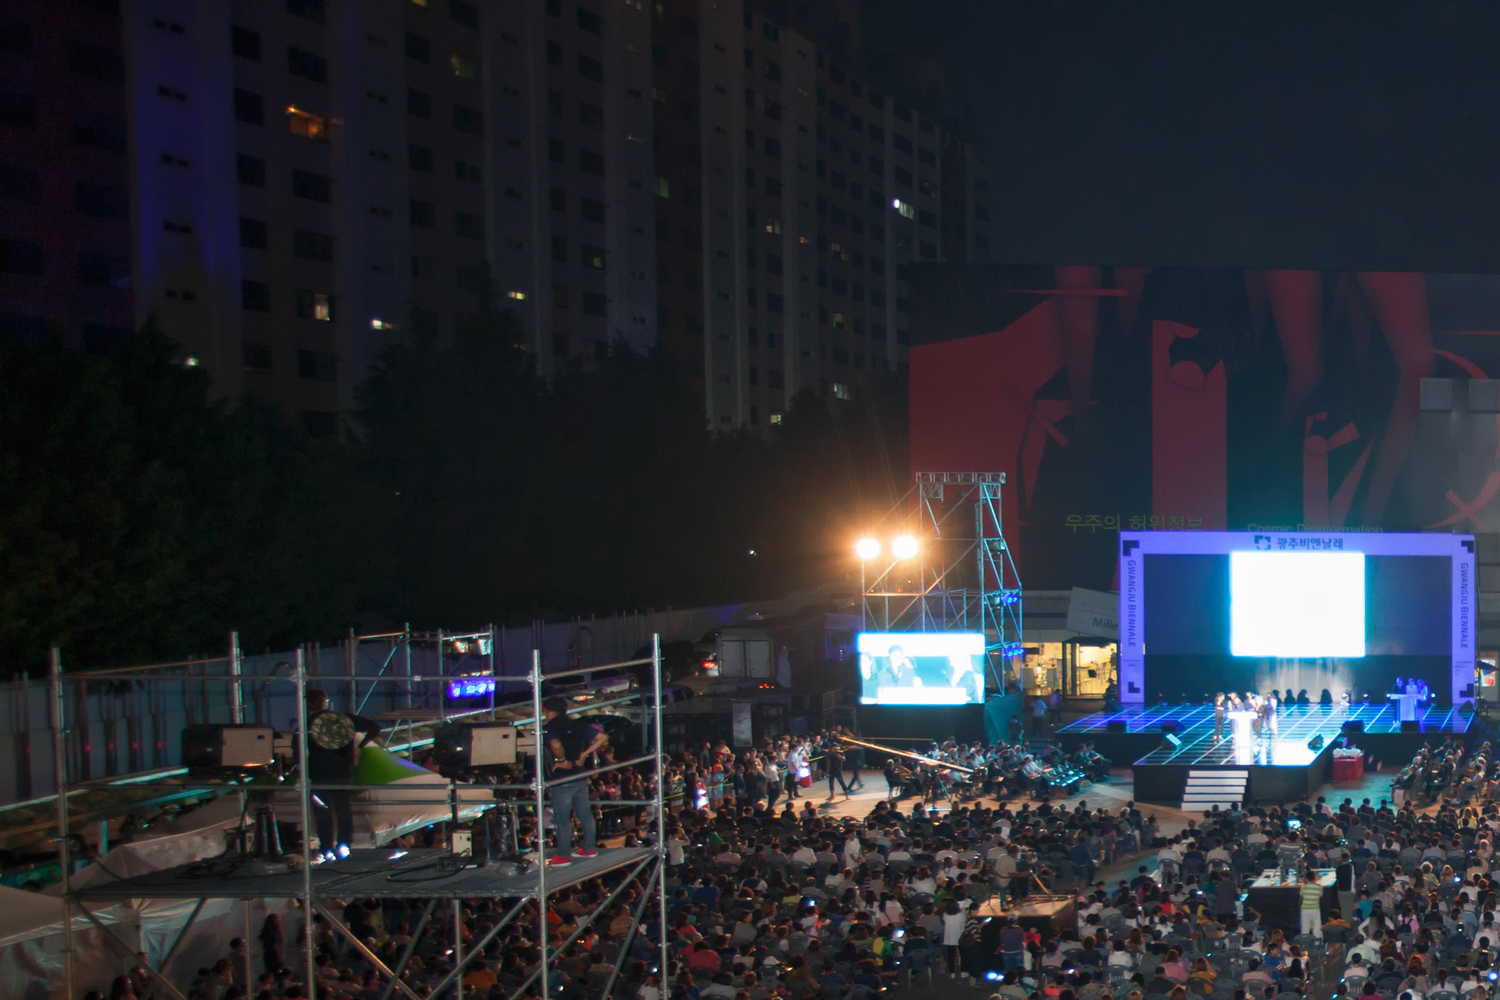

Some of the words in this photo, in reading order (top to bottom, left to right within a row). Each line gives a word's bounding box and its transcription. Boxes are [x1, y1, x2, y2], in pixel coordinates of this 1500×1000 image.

[1065, 514, 1120, 533] 우주의
[1277, 538, 1343, 550] 광주비엔날레
[1127, 559, 1136, 603] GWANGJU
[1460, 562, 1469, 604] GWANGJU
[1128, 604, 1136, 647] BIENNALE
[1461, 606, 1469, 649] BIENNALE
